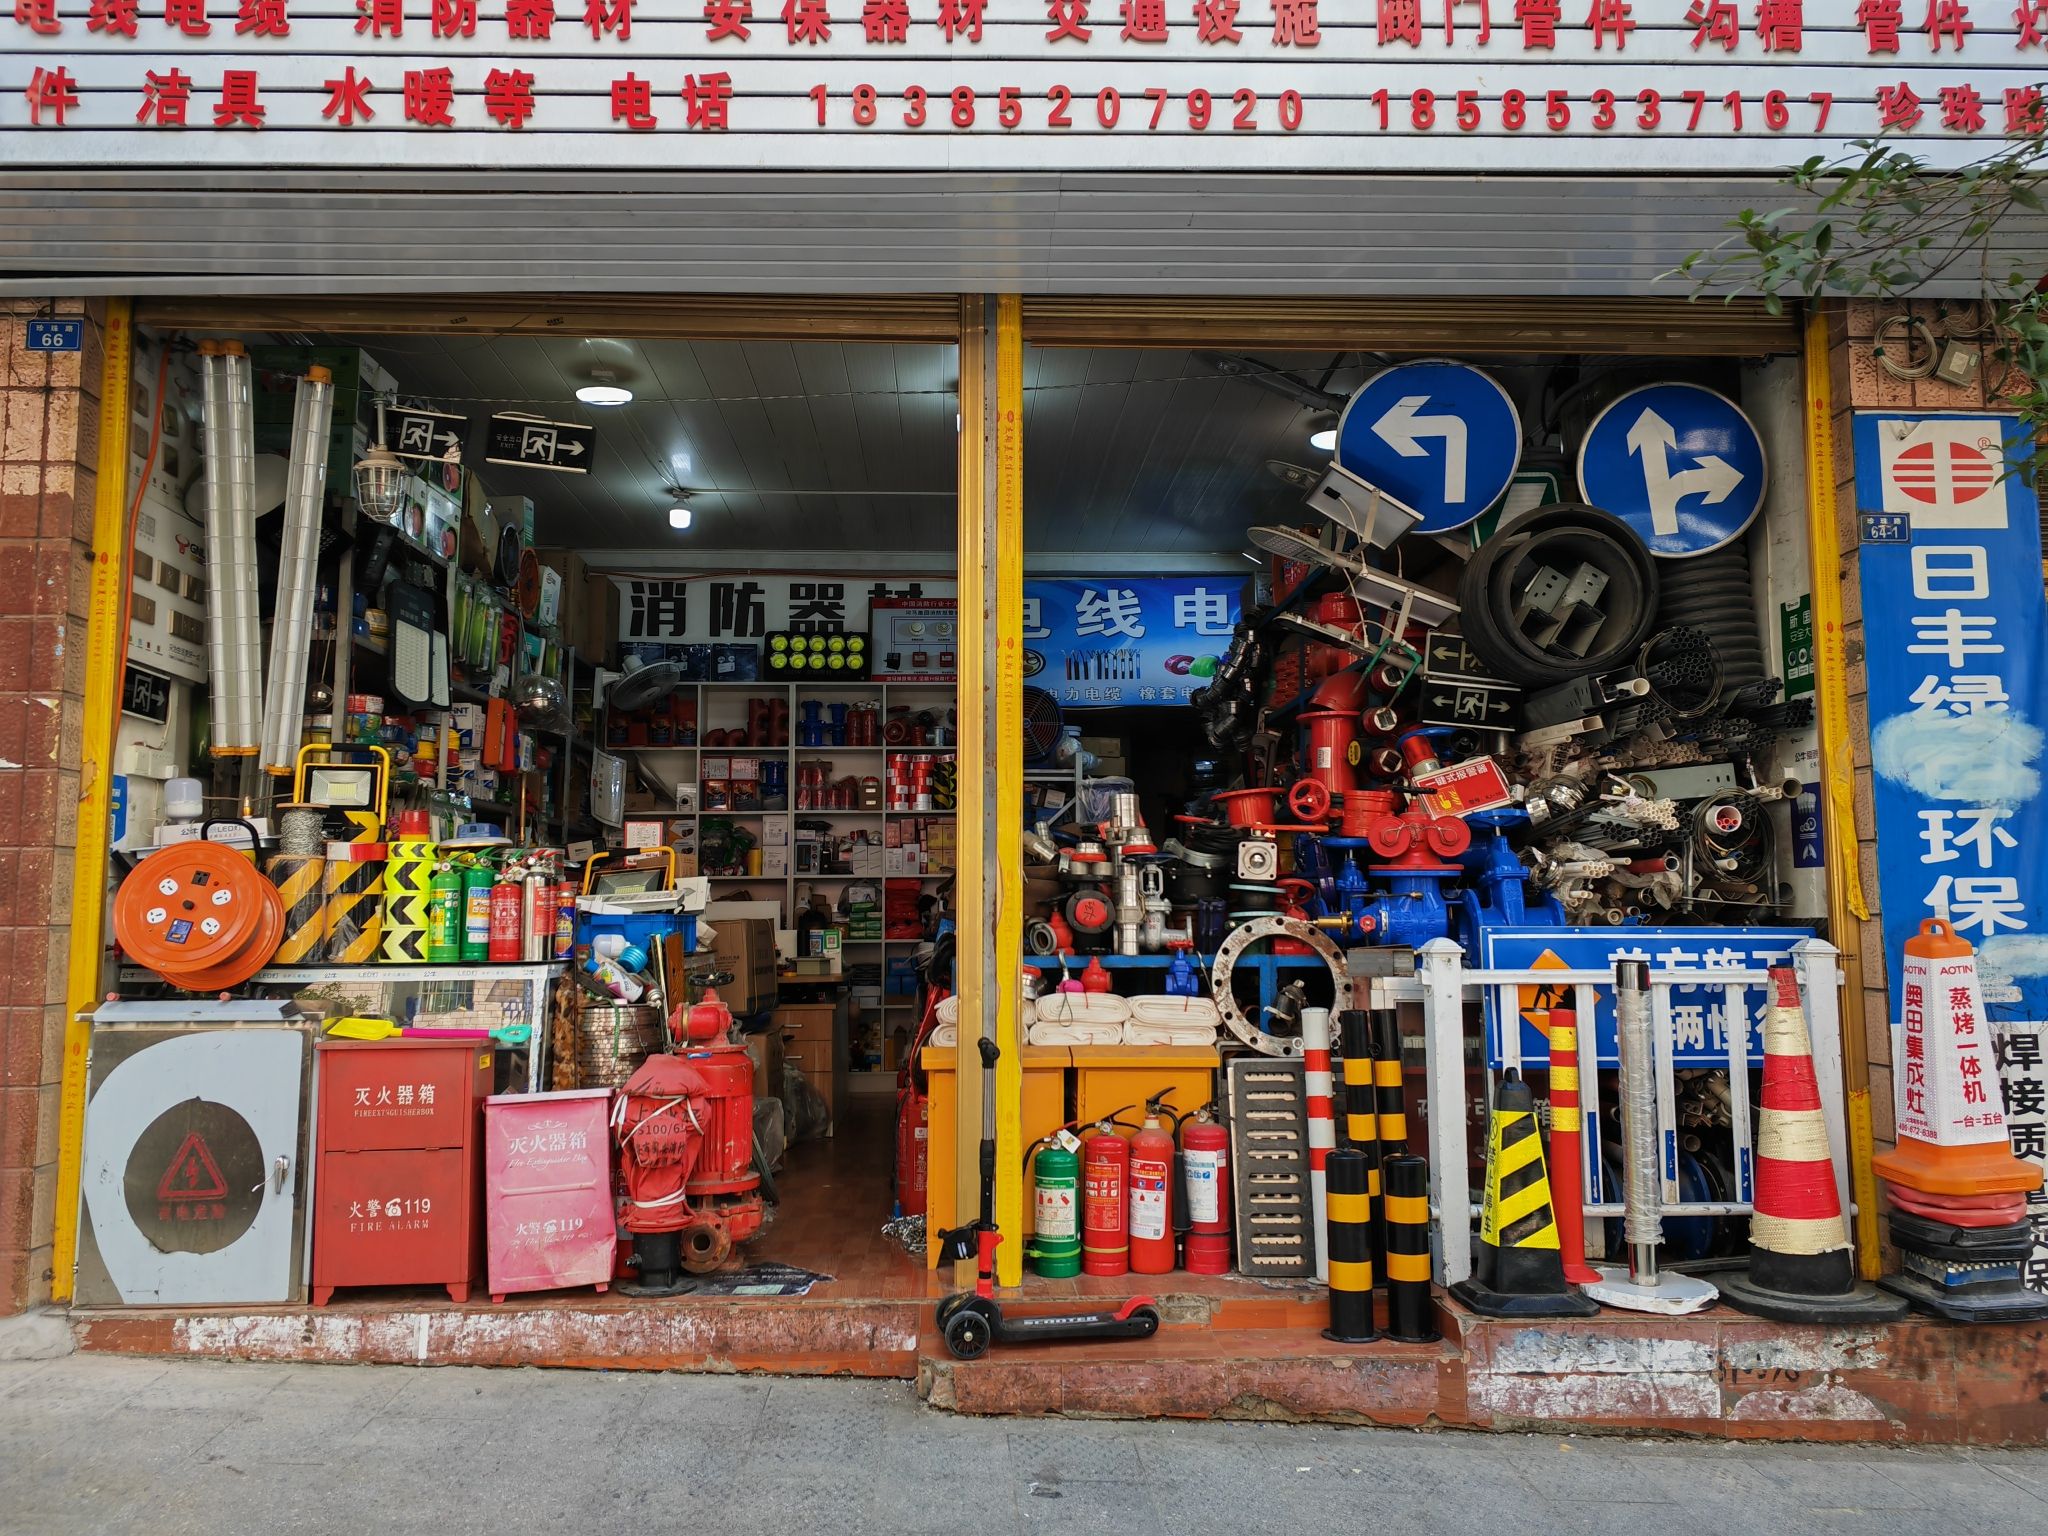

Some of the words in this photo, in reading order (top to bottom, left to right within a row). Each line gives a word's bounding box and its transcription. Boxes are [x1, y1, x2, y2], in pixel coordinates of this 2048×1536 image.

[13, 0, 291, 37] 电线电缆
[354, 0, 637, 39] 消防器材
[703, 0, 988, 44] 安保器材
[1046, 0, 1321, 45] 交通设施
[1376, 0, 1637, 49] 阀门管件
[1684, 0, 1803, 52] 沟槽
[1857, 0, 1974, 52] 管件
[24, 66, 80, 126] 件
[136, 67, 267, 130] 洁具
[322, 66, 536, 129] 水暖等
[610, 71, 734, 129] 电话
[809, 83, 1303, 130] 18385207920
[1371, 88, 1834, 132] 18585337167
[1876, 81, 2048, 134] 珍珠路
[42, 333, 63, 346] 66
[1871, 525, 1899, 539] 64-1
[1907, 546, 2028, 936] 日丰绿环保
[1904, 965, 1927, 977] AOTIN
[1940, 964, 1973, 976] AOTIN
[1905, 982, 1925, 1115] 奥田集成灶
[1948, 986, 1986, 1105] 蒸烤一体机
[354, 1084, 436, 1106] 灭火器箱
[1952, 1112, 2003, 1128] 一台=五台
[508, 1132, 587, 1156] 灭火器箱
[349, 1199, 383, 1219] 火警
[404, 1198, 431, 1215] 119
[350, 1221, 382, 1233] FIRE
[389, 1219, 429, 1231] ALARM
[516, 1222, 542, 1237] 火警
[560, 1217, 584, 1232] 119
